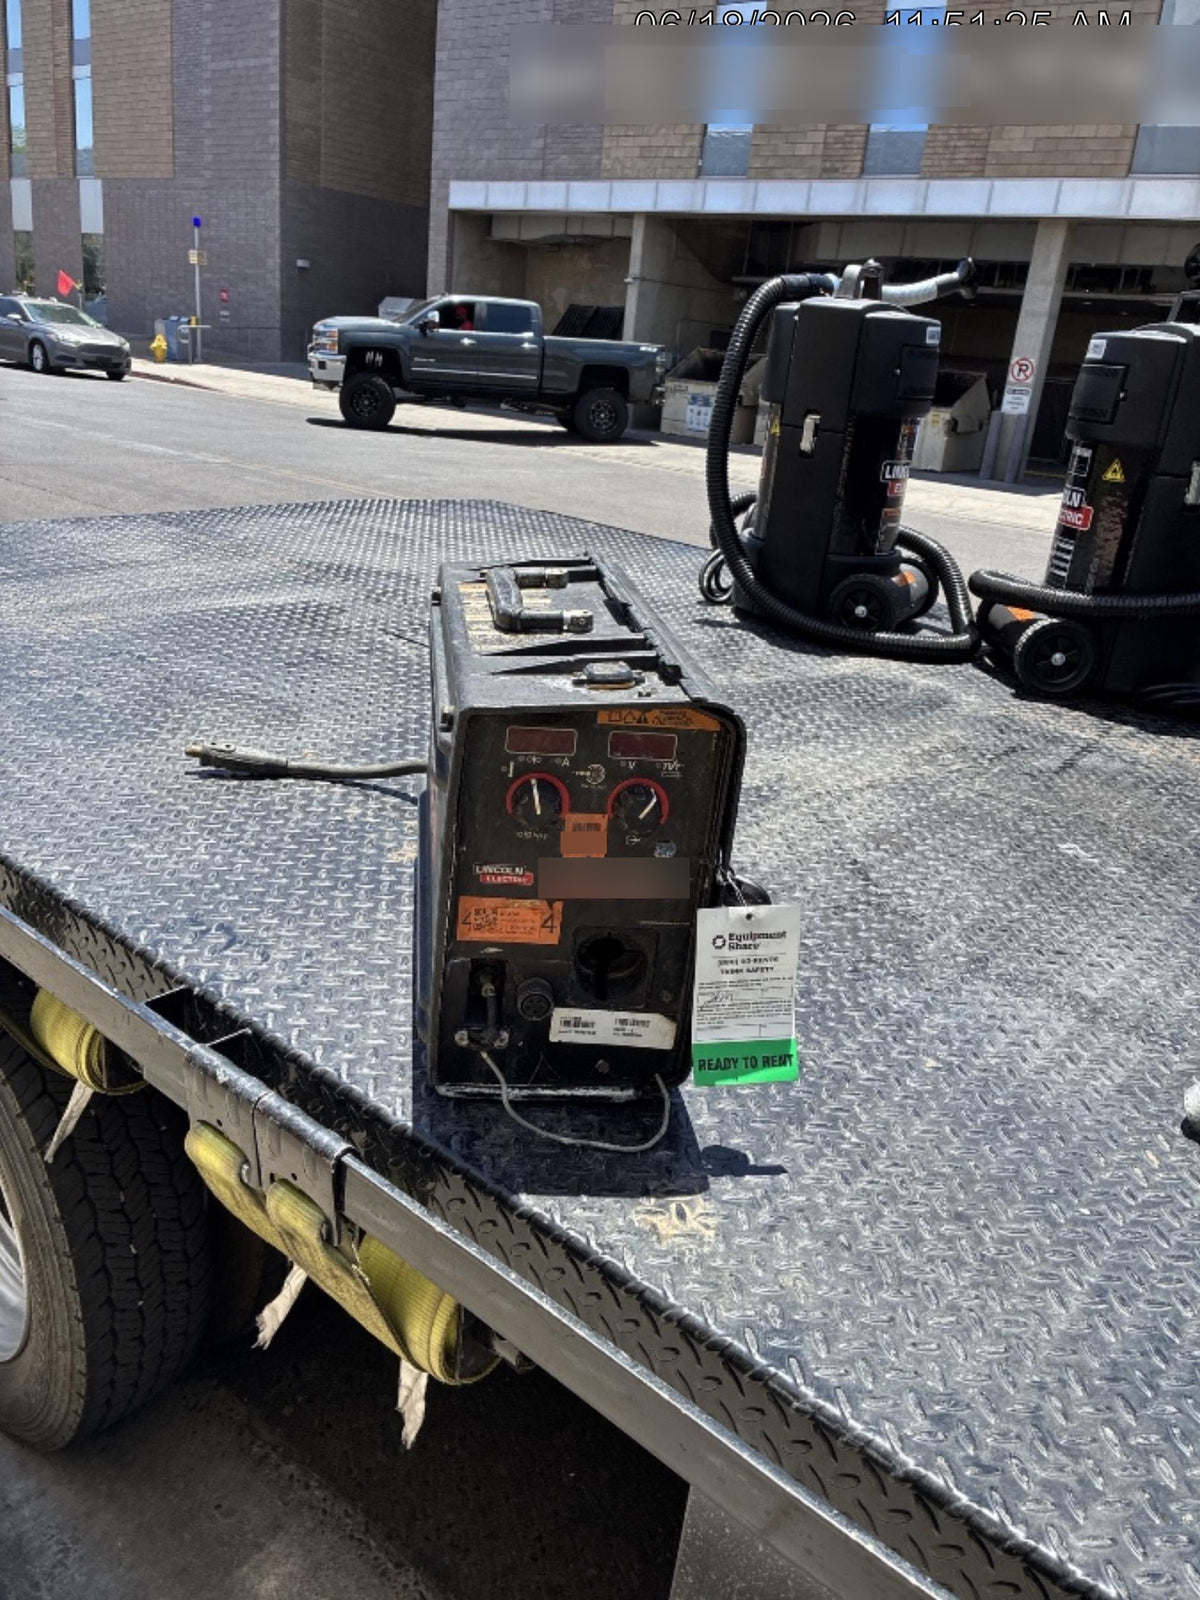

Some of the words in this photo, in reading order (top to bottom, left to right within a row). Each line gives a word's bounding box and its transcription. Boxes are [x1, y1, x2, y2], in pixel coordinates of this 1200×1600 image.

[541, 912, 557, 934] 4
[728, 931, 787, 942] Equipment
[728, 941, 760, 950] Share
[698, 1057, 738, 1071] READY
[741, 1055, 758, 1069] TO
[762, 1053, 794, 1068] RENT
